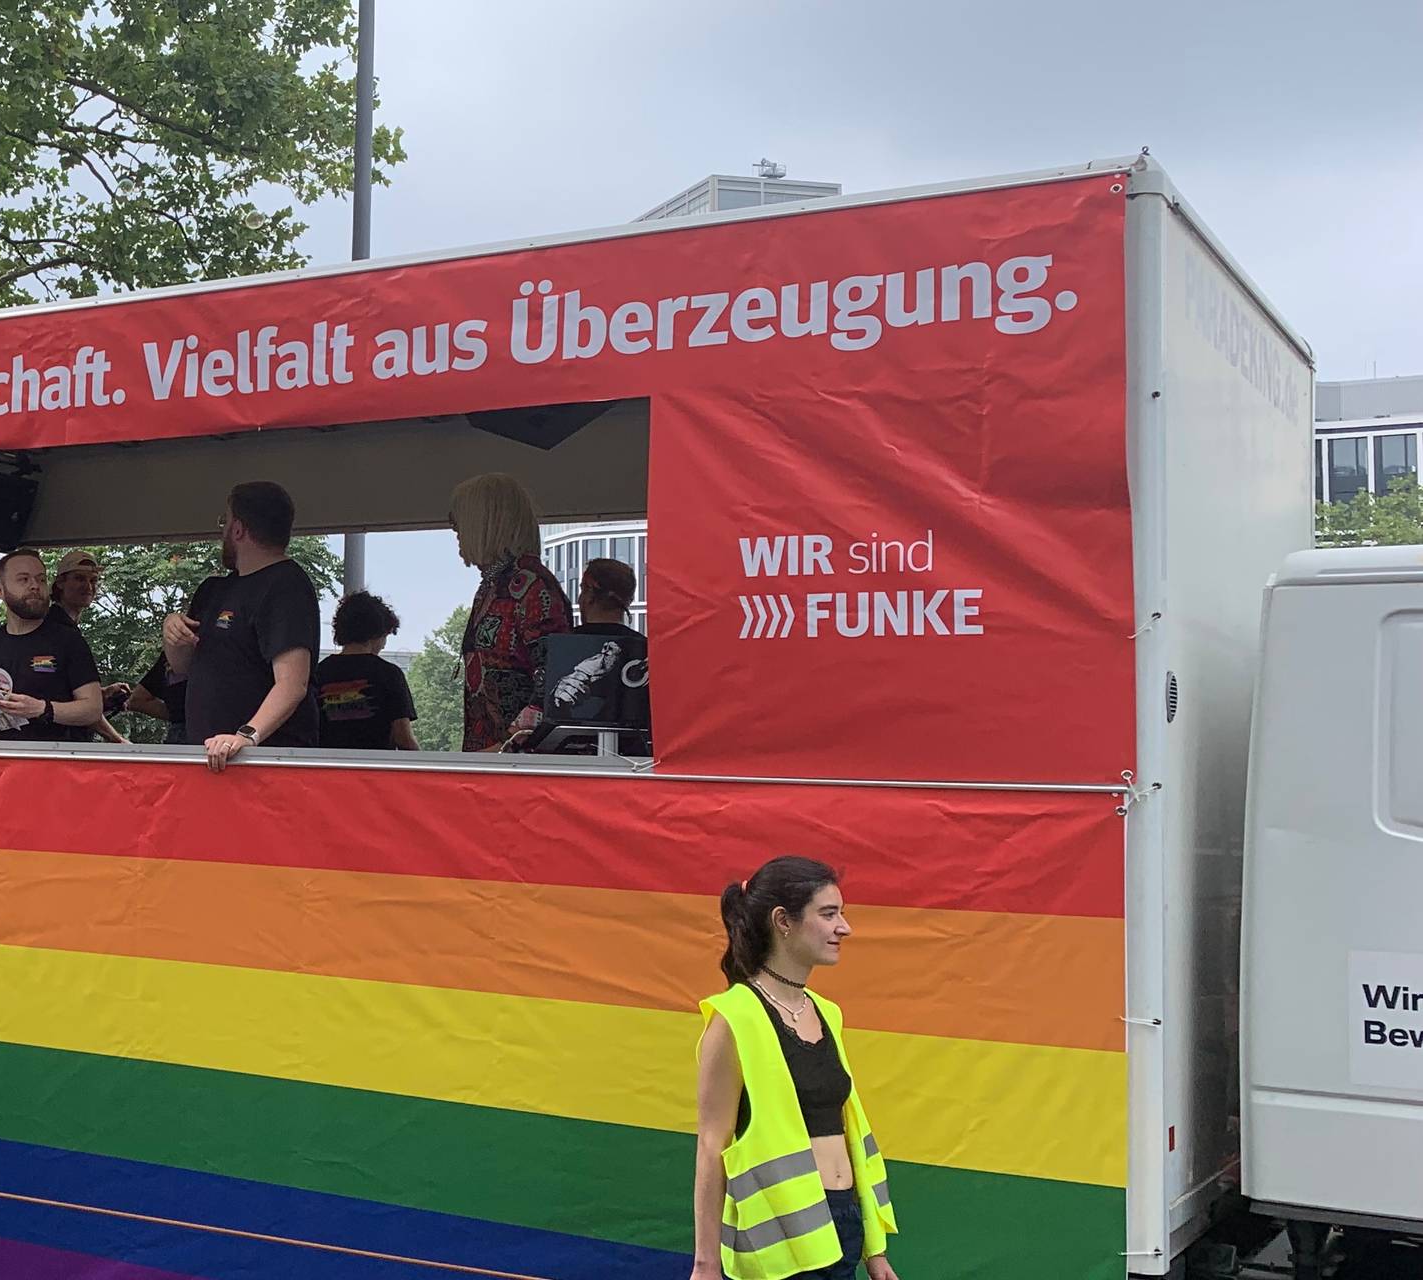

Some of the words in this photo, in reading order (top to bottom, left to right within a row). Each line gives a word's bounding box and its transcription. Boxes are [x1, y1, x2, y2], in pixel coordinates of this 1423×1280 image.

[143, 319, 355, 400] Vielfalt
[374, 313, 490, 379] aus
[508, 252, 1080, 366] Überzeugung.
[738, 534, 835, 578] WIR
[848, 529, 934, 575] sind
[806, 588, 985, 638] FUNKE
